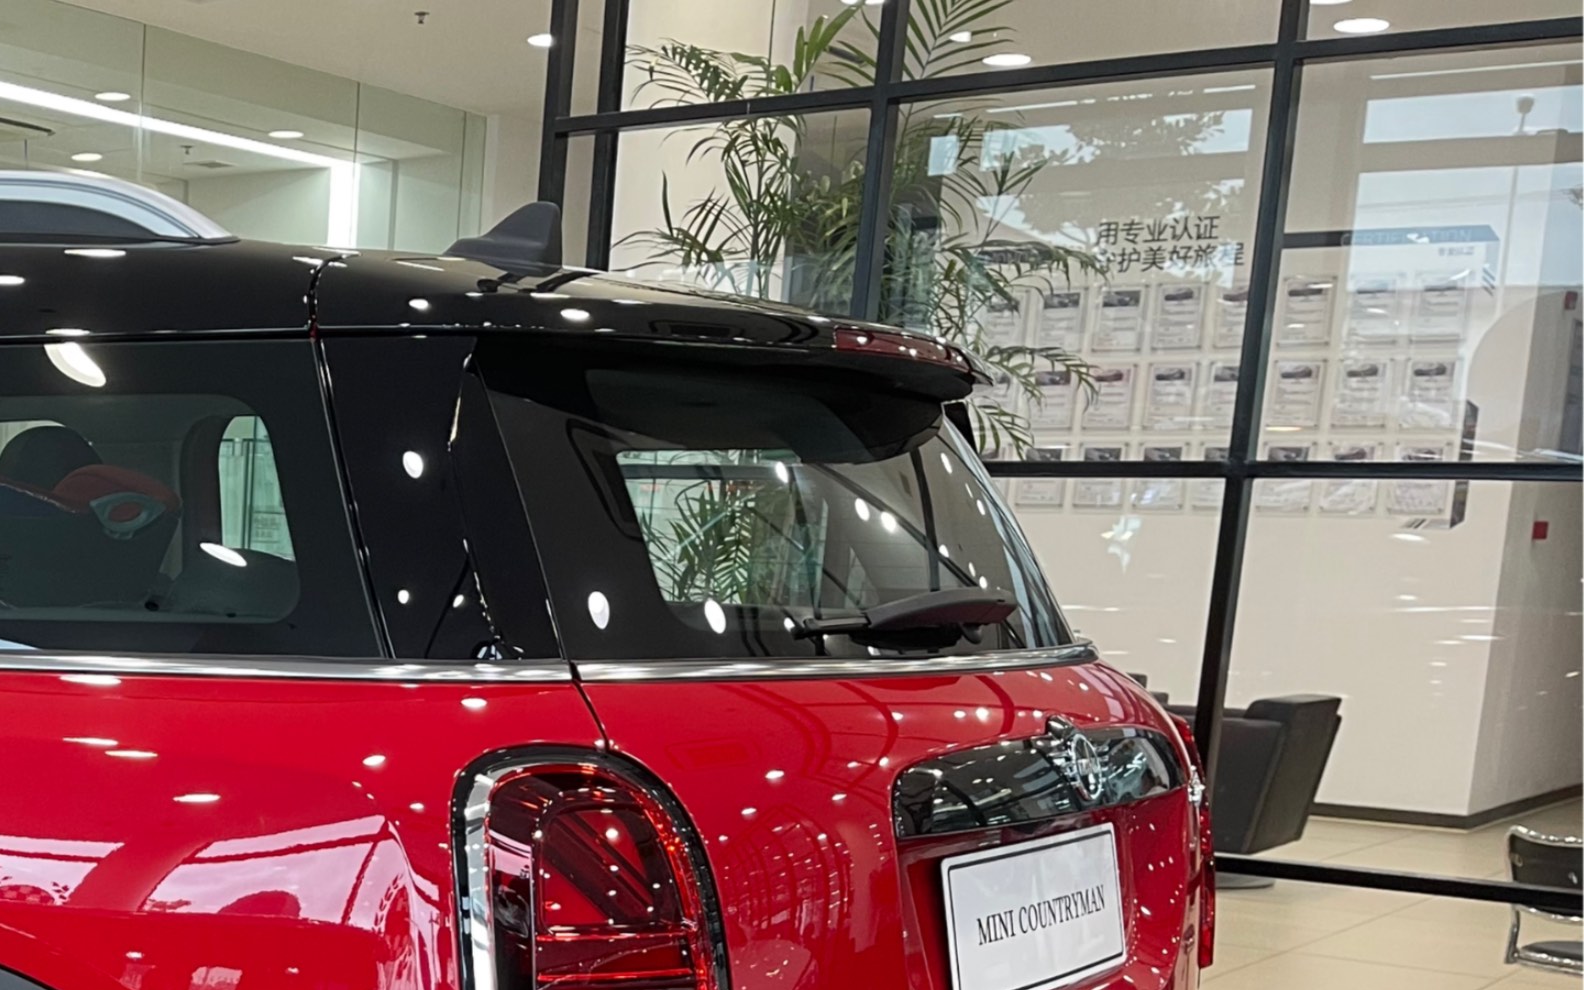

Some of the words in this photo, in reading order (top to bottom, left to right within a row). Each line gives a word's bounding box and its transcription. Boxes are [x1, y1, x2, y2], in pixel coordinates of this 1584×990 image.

[1096, 215, 1221, 246] 用专业认证
[976, 909, 1016, 946] MINI
[1018, 884, 1106, 934] COUNTRYMAN
